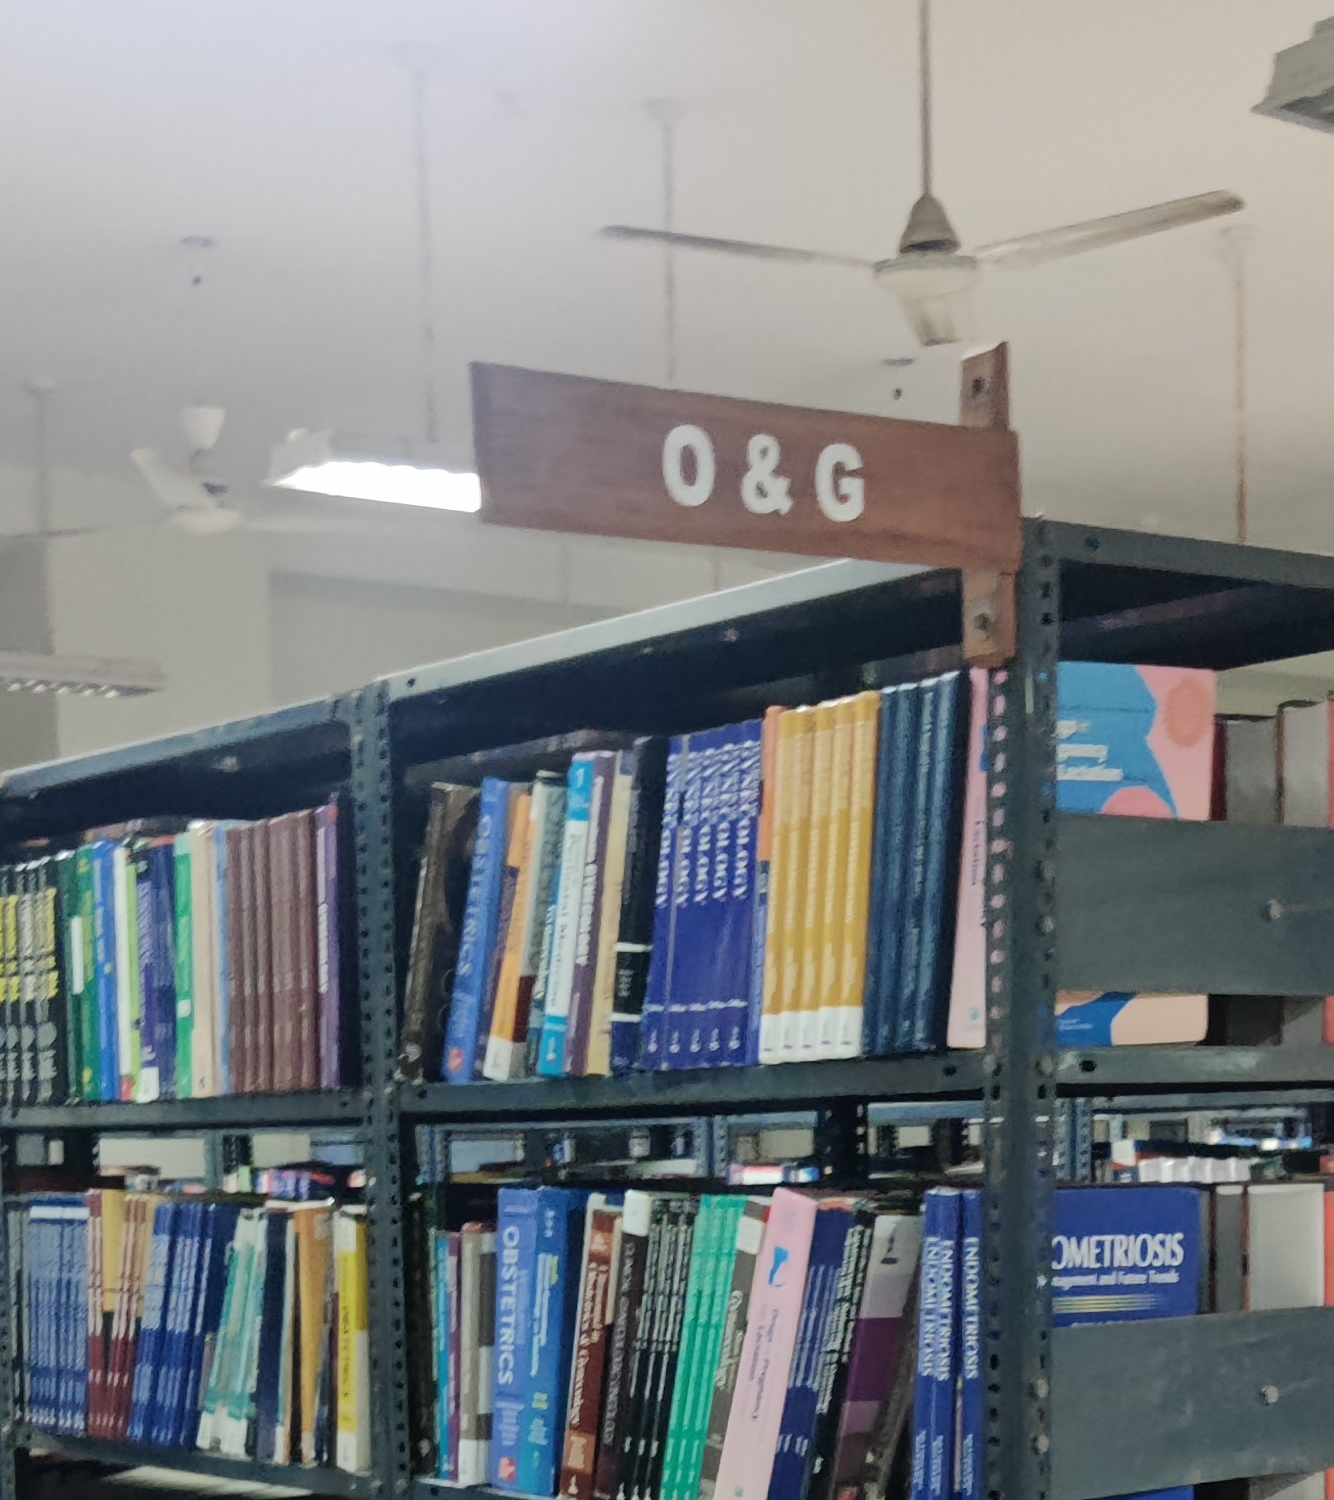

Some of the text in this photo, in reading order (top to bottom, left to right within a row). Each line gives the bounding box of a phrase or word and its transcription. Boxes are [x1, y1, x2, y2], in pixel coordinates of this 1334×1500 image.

[662, 424, 865, 522] O & G
[1051, 1232, 1185, 1270] OMETRIOSIS
[497, 1225, 520, 1386] OBSTETRICS
